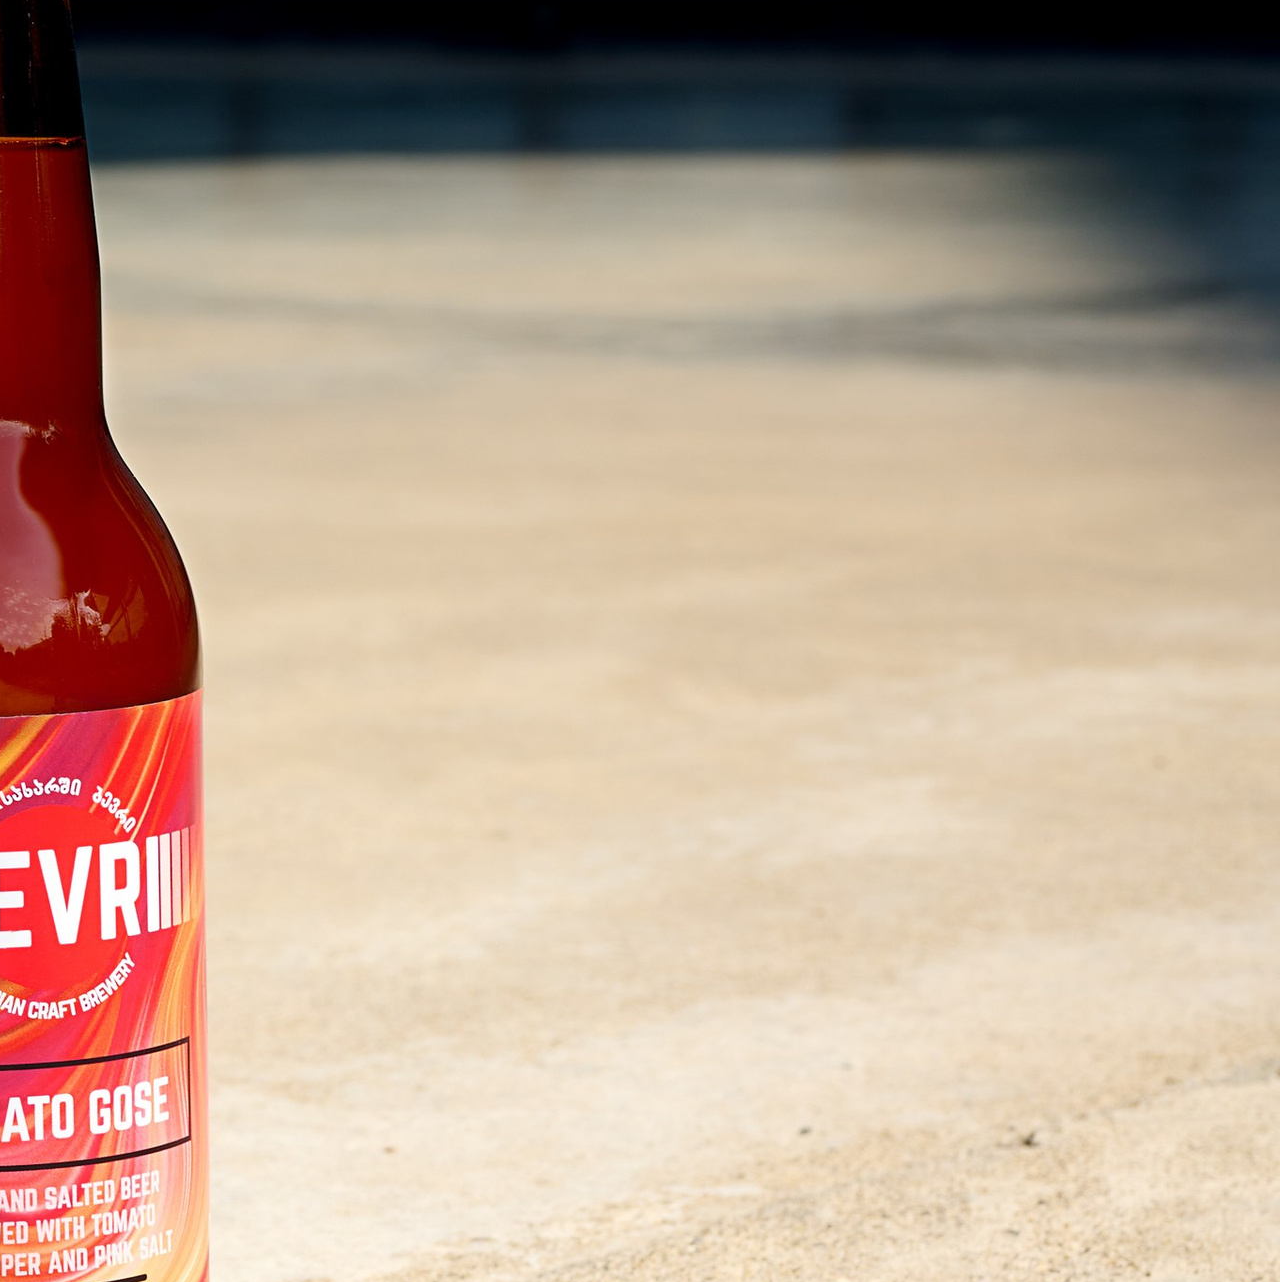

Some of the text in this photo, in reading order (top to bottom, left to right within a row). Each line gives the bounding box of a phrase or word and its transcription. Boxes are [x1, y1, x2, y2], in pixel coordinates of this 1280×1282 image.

[92, 786, 136, 833] ბევრი
[27, 998, 76, 1019] CRAFT
[81, 952, 135, 1012] BREWERY
[89, 1076, 169, 1134] GOSE
[44, 1179, 115, 1210] SALTED
[121, 1170, 160, 1200] BEER
[36, 1216, 85, 1243] WITH
[91, 1203, 156, 1237] TOMATO
[48, 1248, 88, 1274] AND
[94, 1238, 134, 1268] PINK
[139, 1229, 173, 1260] SALT
